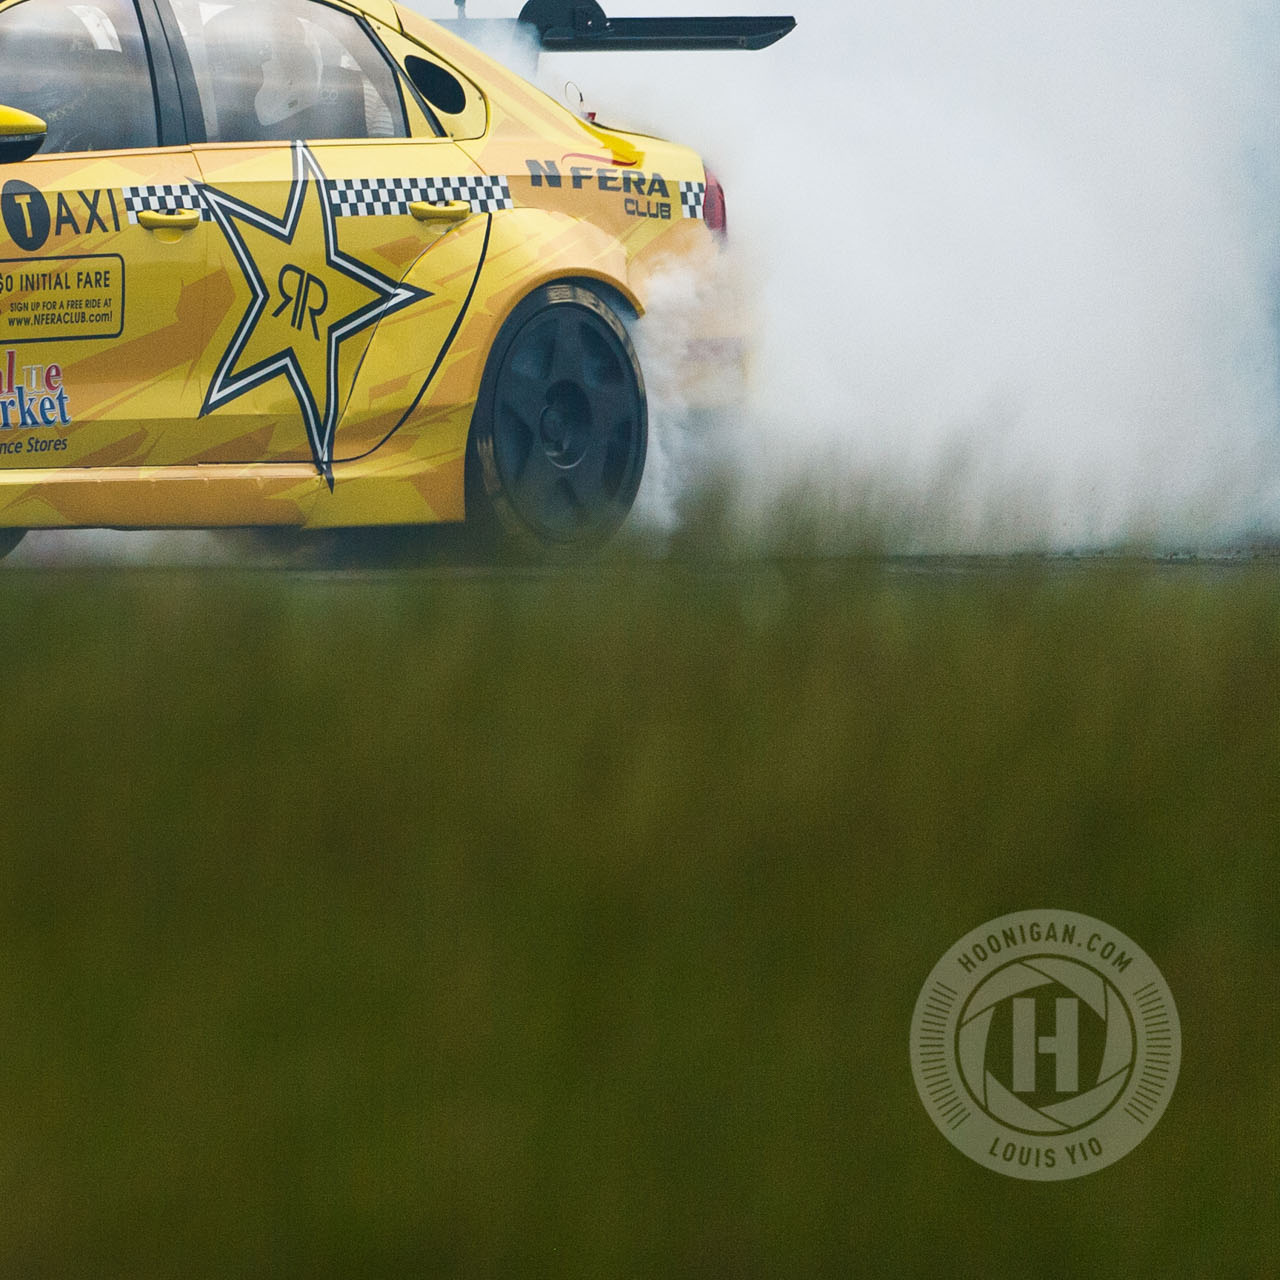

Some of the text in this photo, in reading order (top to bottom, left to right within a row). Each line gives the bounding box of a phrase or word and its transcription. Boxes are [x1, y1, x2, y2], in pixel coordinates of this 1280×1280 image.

[624, 198, 671, 220] CLUB
[20, 273, 71, 292] INITIAL
[76, 270, 111, 289] FARE
[10, 298, 112, 312] SIGN UP FOR A FREE RIDE AT
[26, 436, 68, 453] Stores
